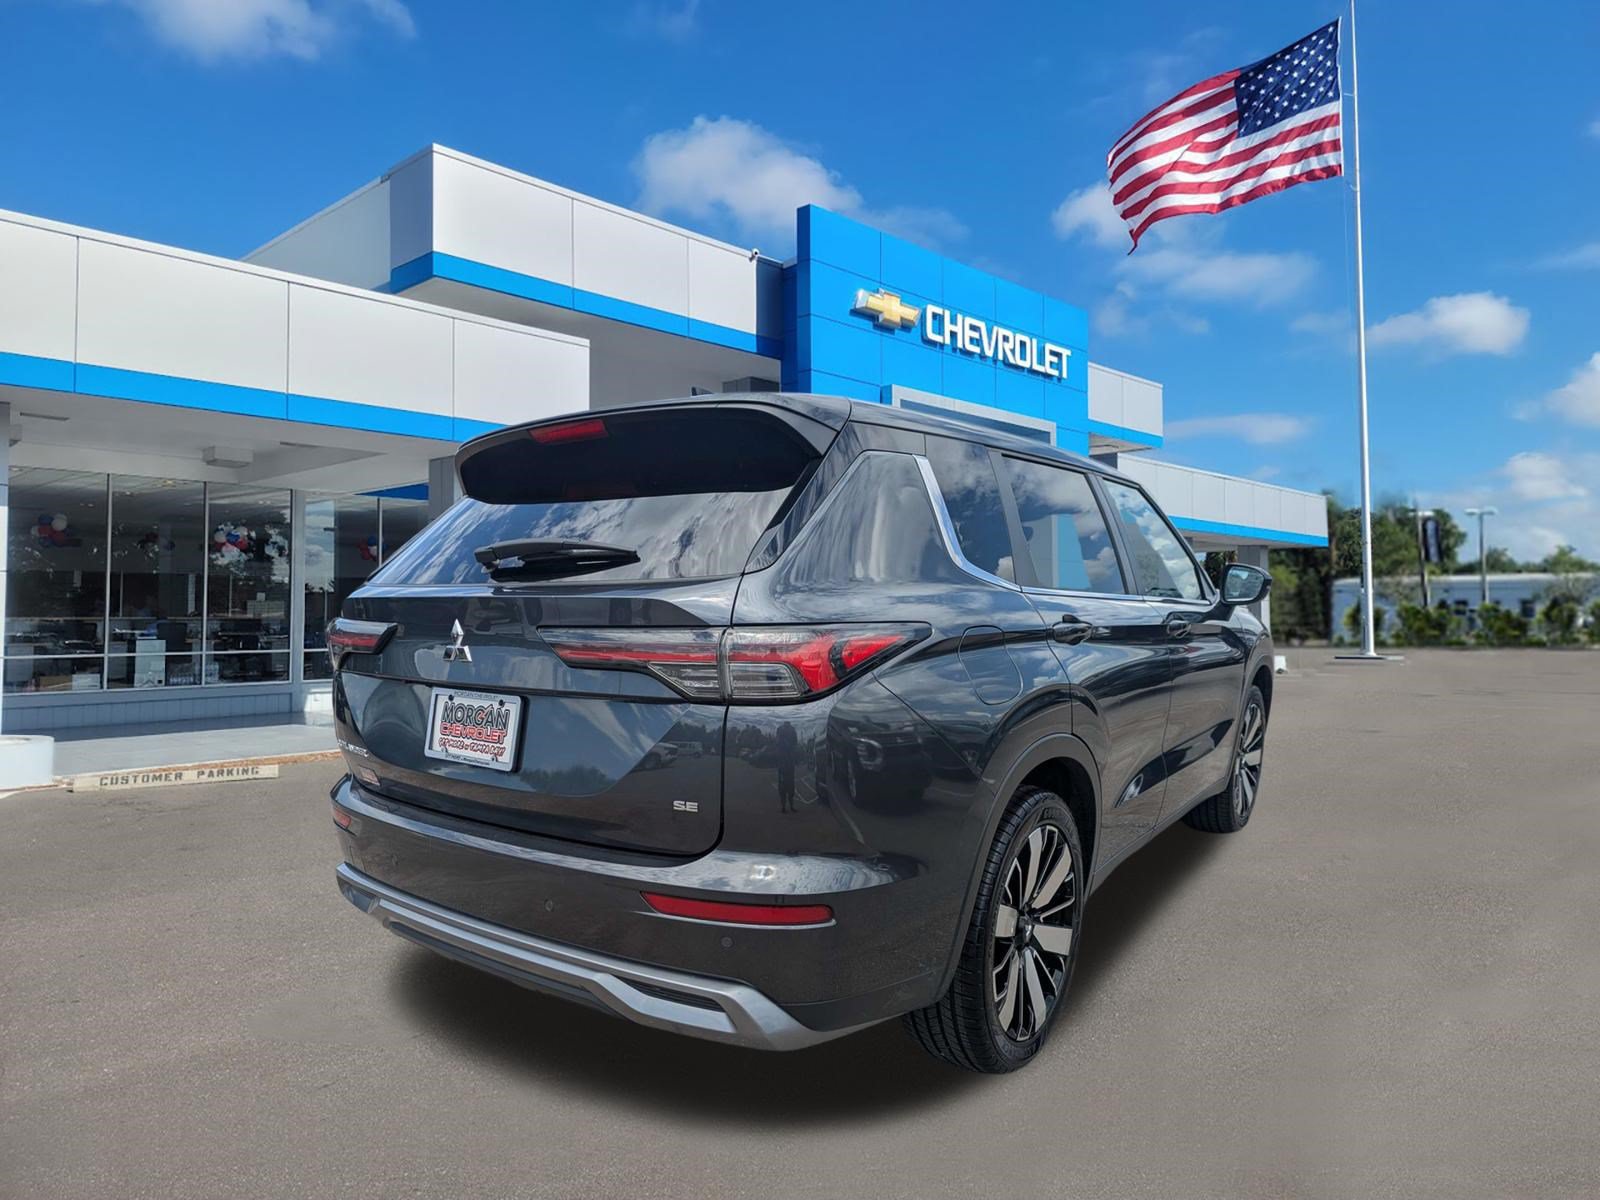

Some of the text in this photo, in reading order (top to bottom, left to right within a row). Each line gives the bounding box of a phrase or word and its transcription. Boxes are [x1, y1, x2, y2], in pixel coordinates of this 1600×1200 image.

[925, 303, 1072, 379] CHEVROLET
[442, 701, 510, 730] MORGAN
[440, 721, 507, 744] CHEVROLET
[99, 766, 260, 786] CUSTOMER PARKING
[673, 800, 698, 812] SE
